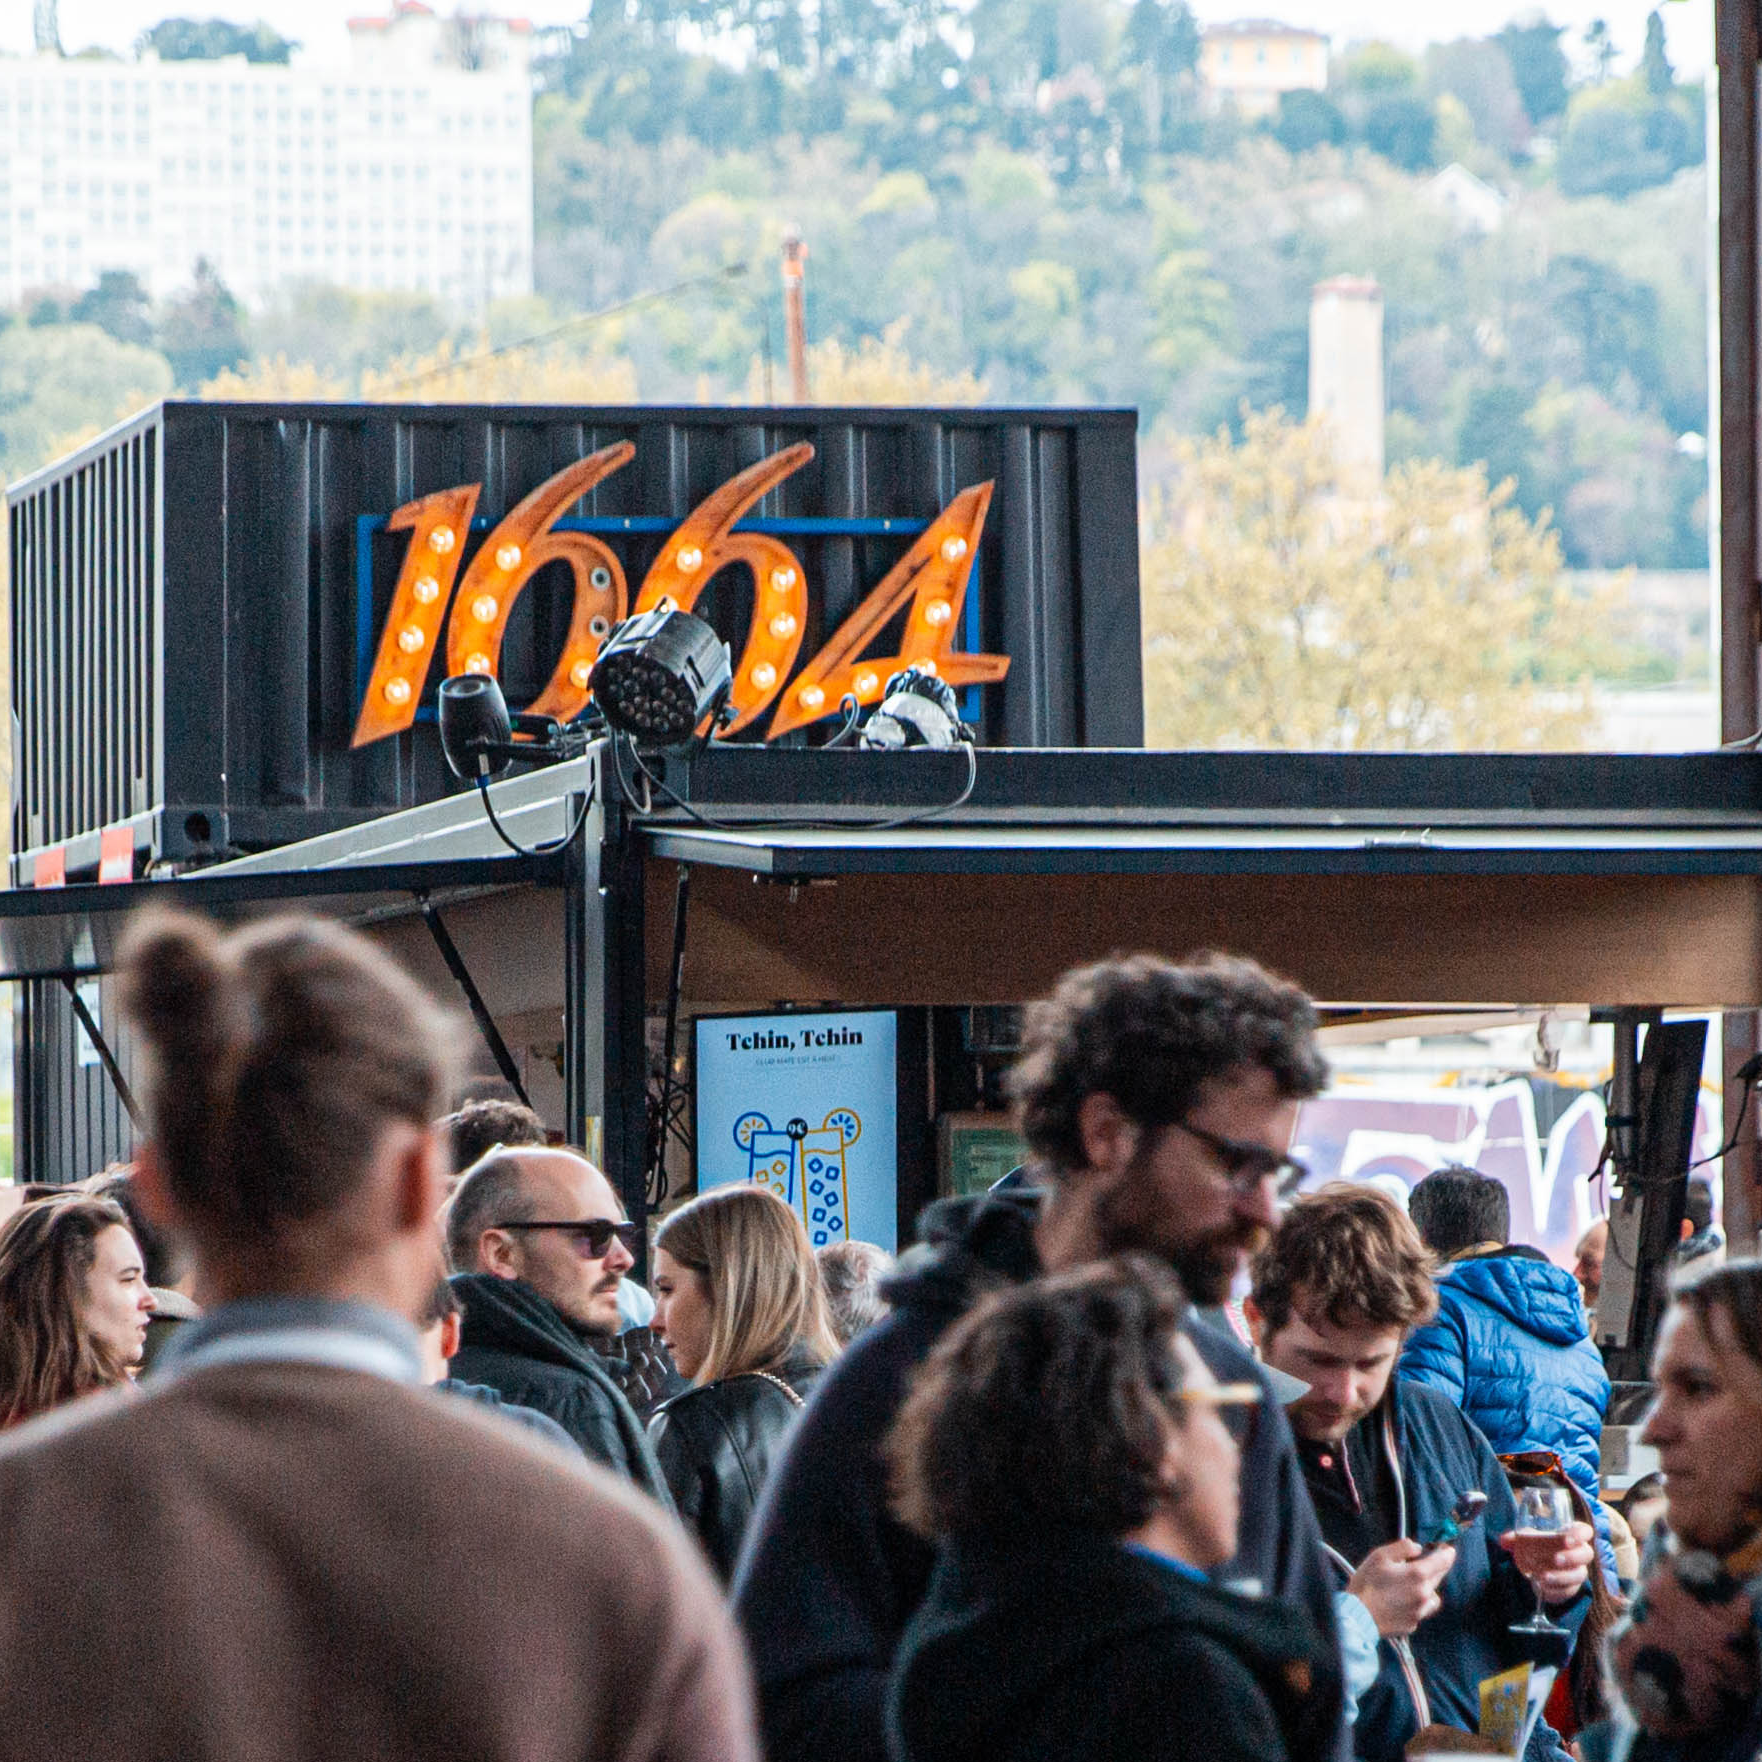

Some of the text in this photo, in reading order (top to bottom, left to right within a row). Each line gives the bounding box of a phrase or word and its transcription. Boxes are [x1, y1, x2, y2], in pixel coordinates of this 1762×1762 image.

[351, 439, 1011, 750] 1664
[725, 1026, 864, 1052] Tchin, Tchin
